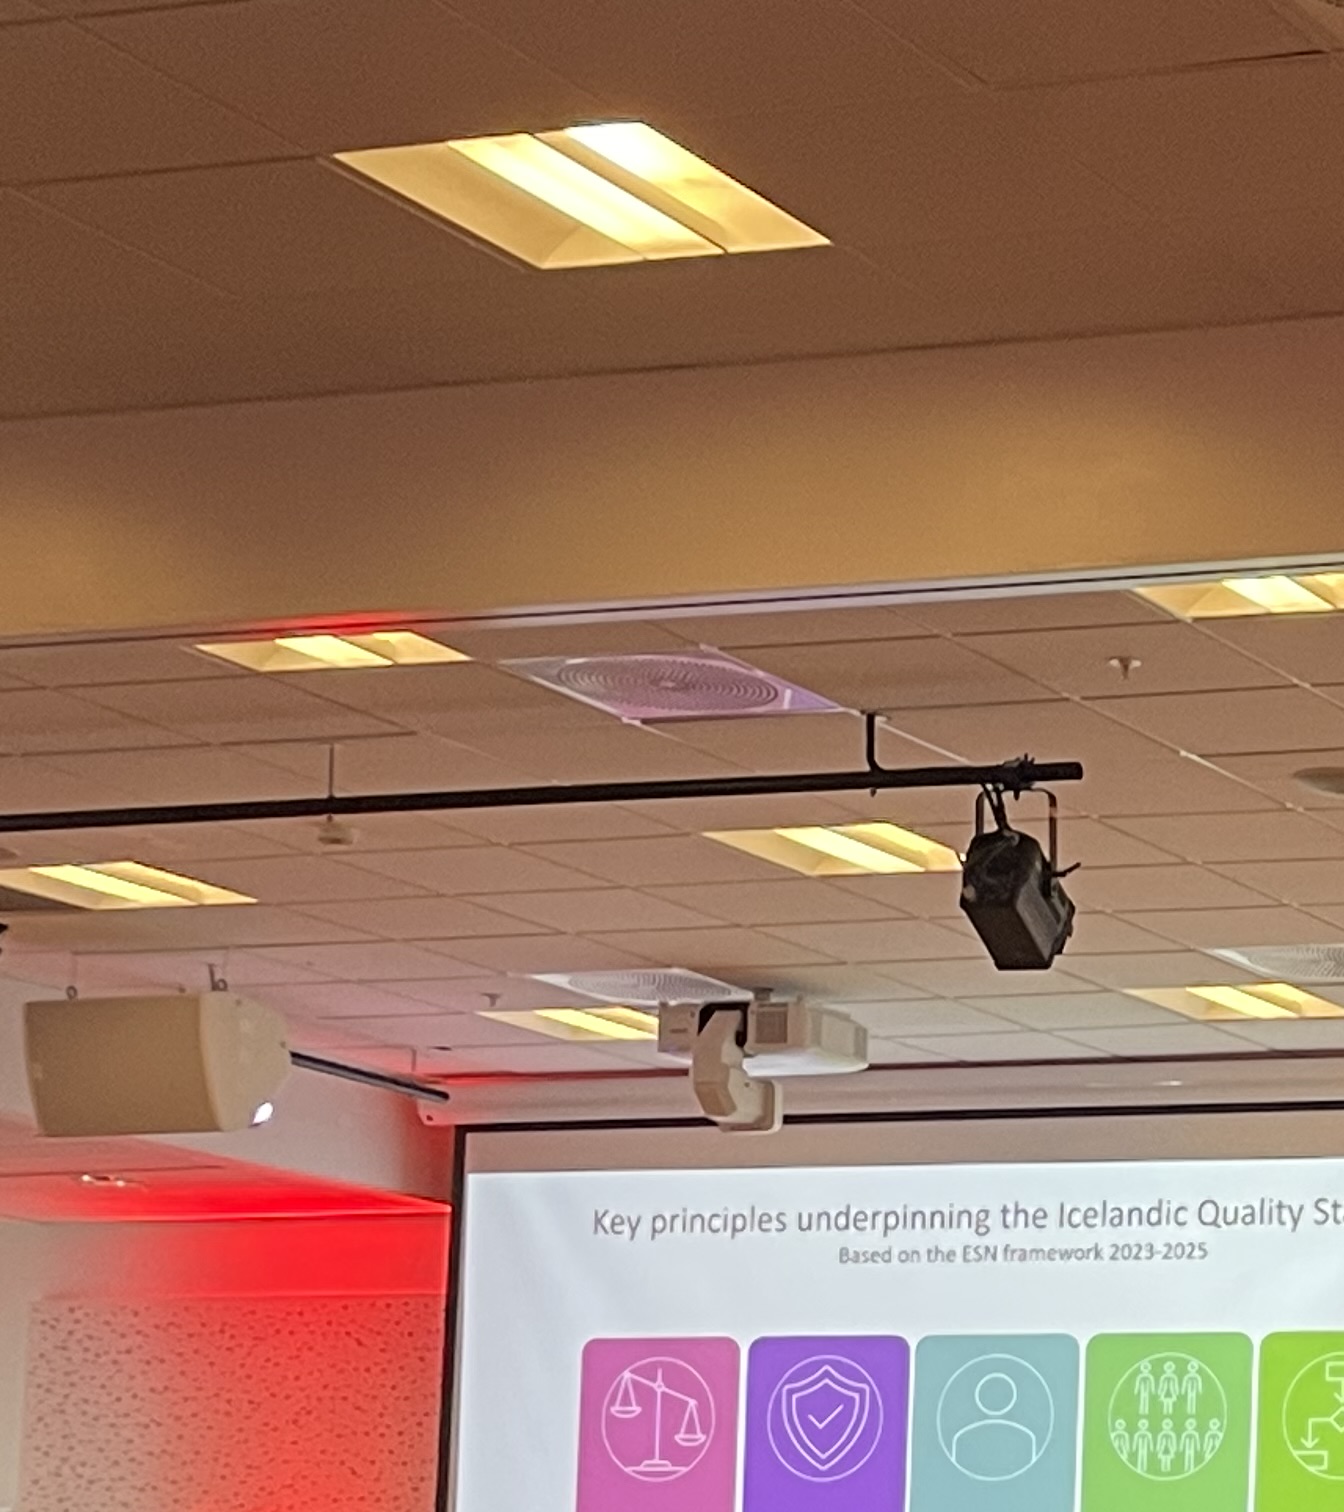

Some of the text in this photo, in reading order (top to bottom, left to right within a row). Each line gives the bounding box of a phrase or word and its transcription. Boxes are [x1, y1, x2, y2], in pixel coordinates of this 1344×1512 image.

[593, 1208, 642, 1242] Key
[650, 1204, 788, 1241] principles
[797, 1202, 991, 1239] underpinning
[1000, 1200, 1049, 1230] the
[1058, 1197, 1189, 1229] Icelandic
[1197, 1196, 1305, 1234] Quality
[838, 1241, 1209, 1265] Based on the ESN framework 2023-2025
